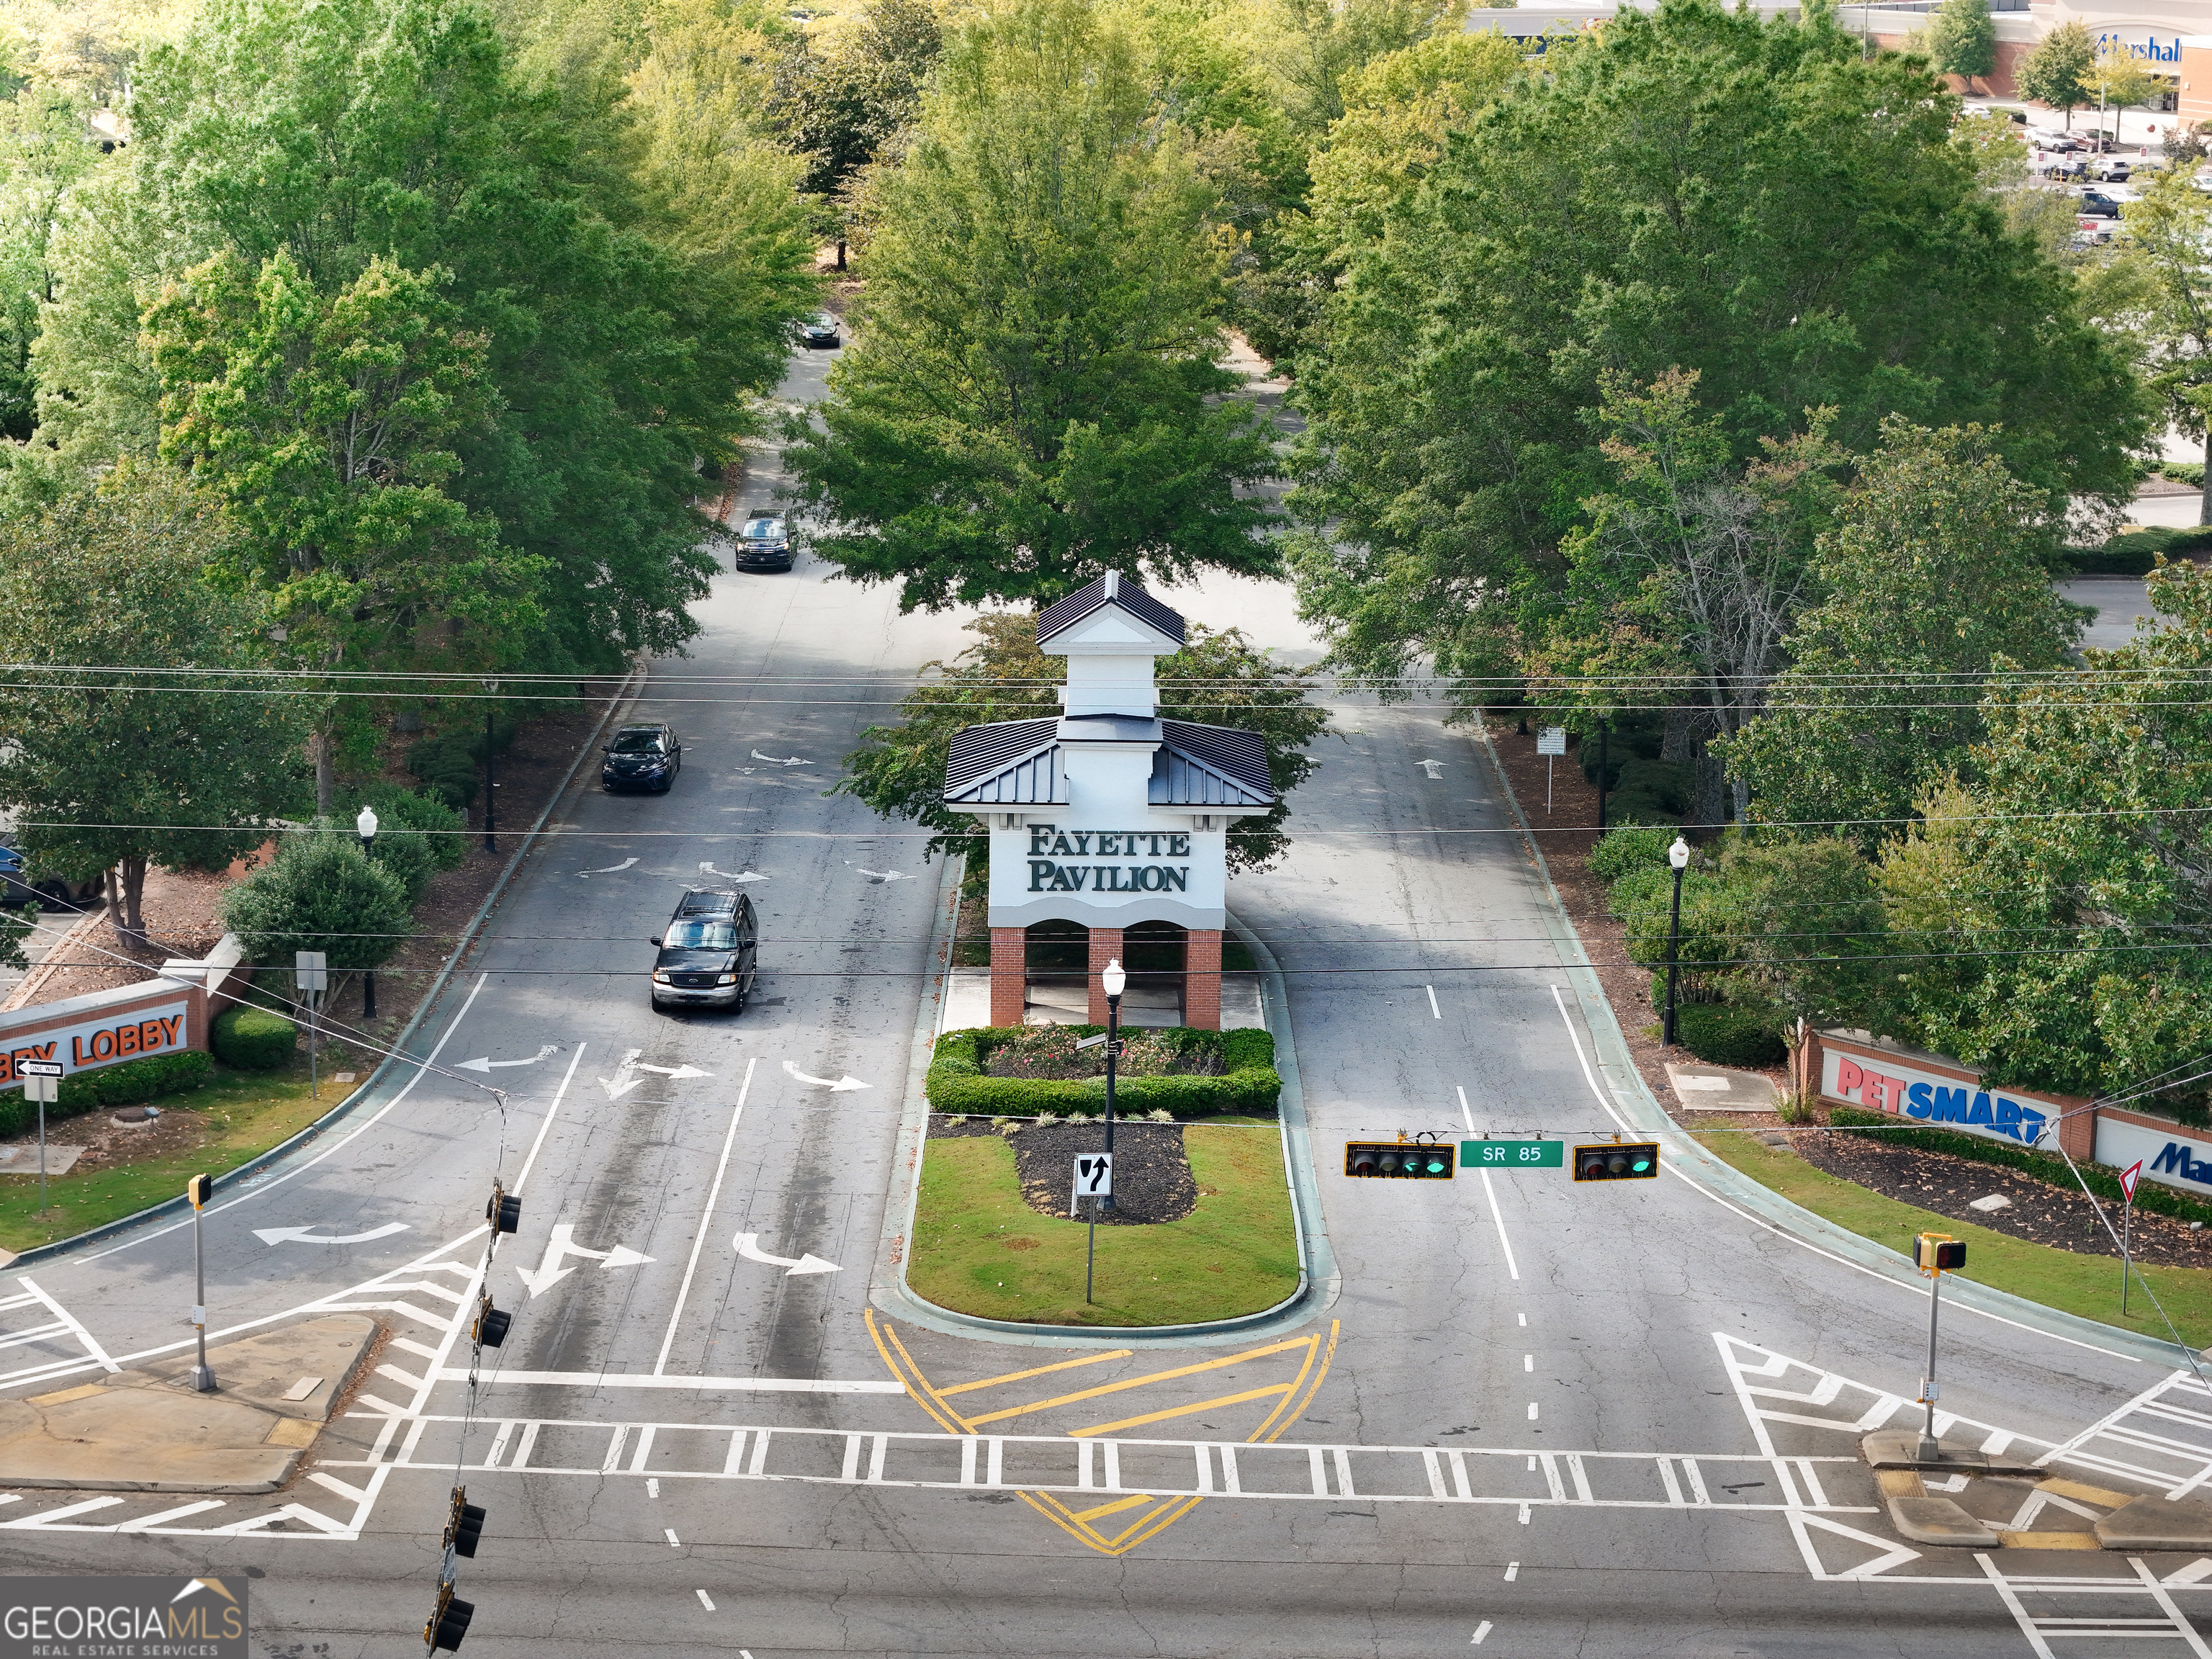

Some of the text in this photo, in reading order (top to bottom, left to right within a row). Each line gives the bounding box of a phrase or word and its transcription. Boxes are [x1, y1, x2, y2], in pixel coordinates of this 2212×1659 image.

[1027, 824, 1190, 857] FAYETTE
[1027, 860, 1190, 892] PAVILION
[72, 1014, 184, 1067] LOBBY
[1837, 1056, 2046, 1145] PETSMART
[1482, 1146, 1542, 1161] SR 85
